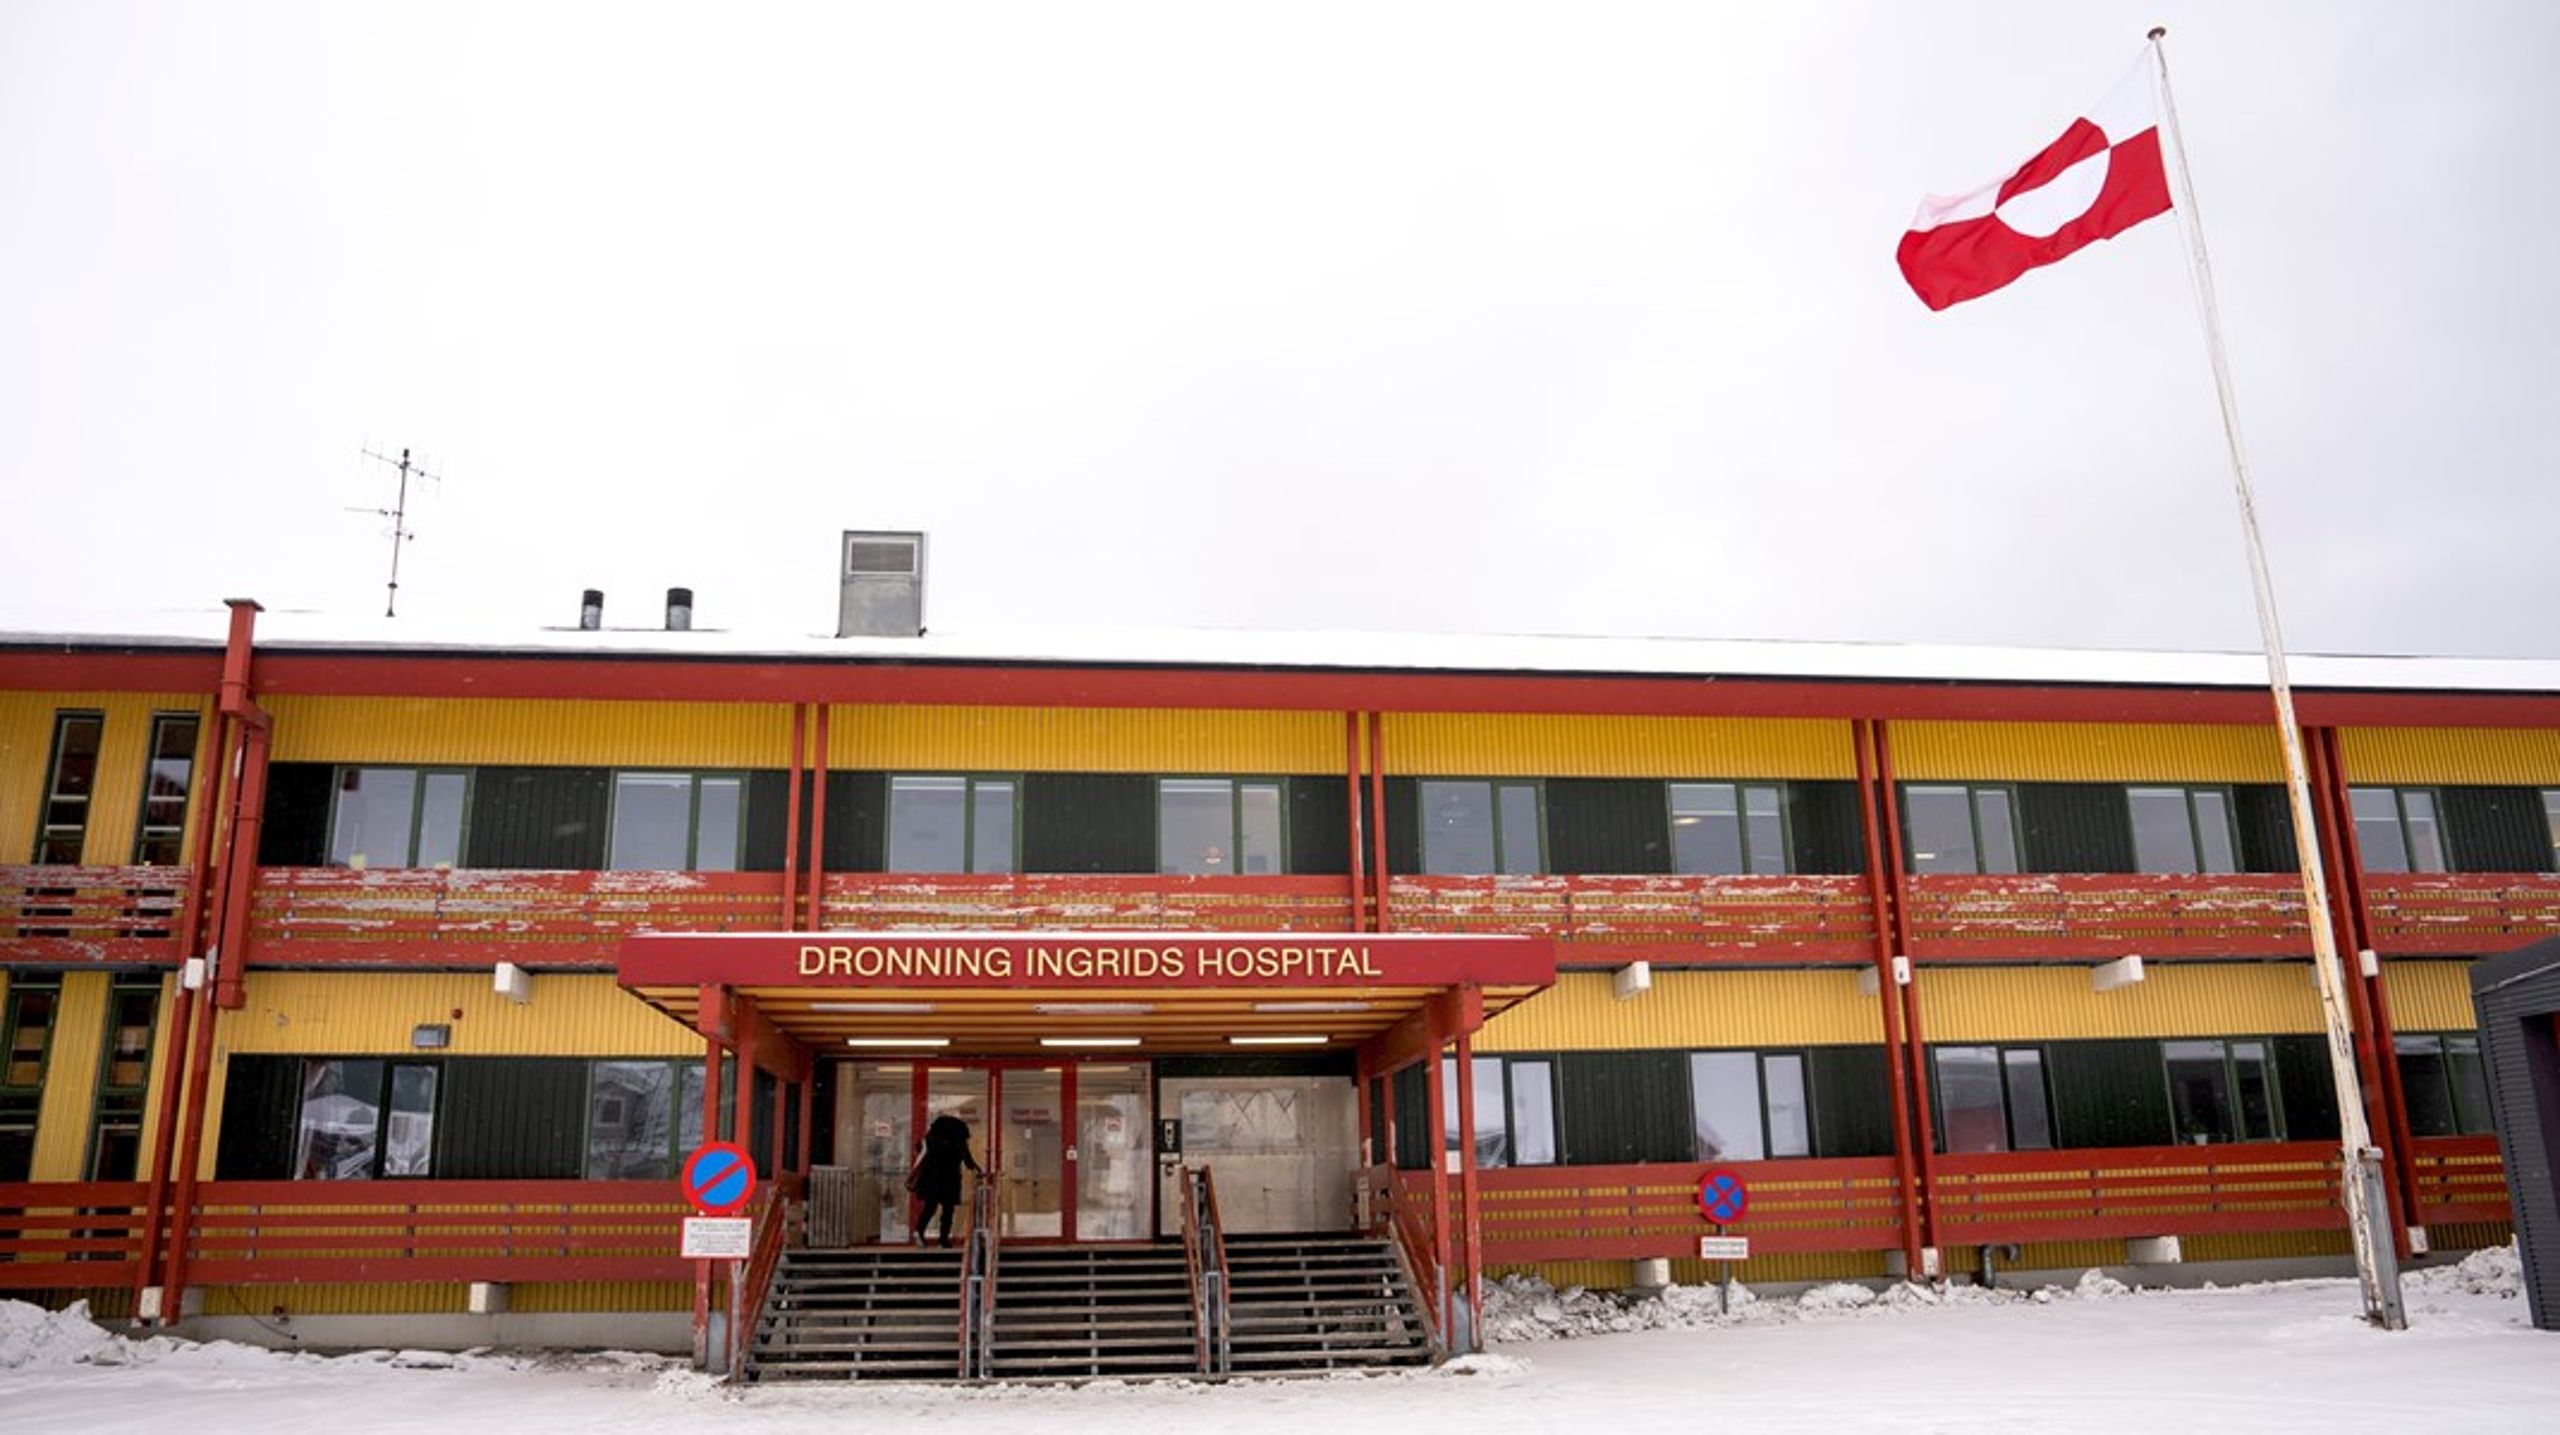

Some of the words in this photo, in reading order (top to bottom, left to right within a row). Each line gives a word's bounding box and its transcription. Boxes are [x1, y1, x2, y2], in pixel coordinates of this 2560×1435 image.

[798, 946, 1011, 977] DRONNING
[1026, 947, 1185, 977] INGRIDS
[1197, 947, 1383, 977] HOSPITAL
